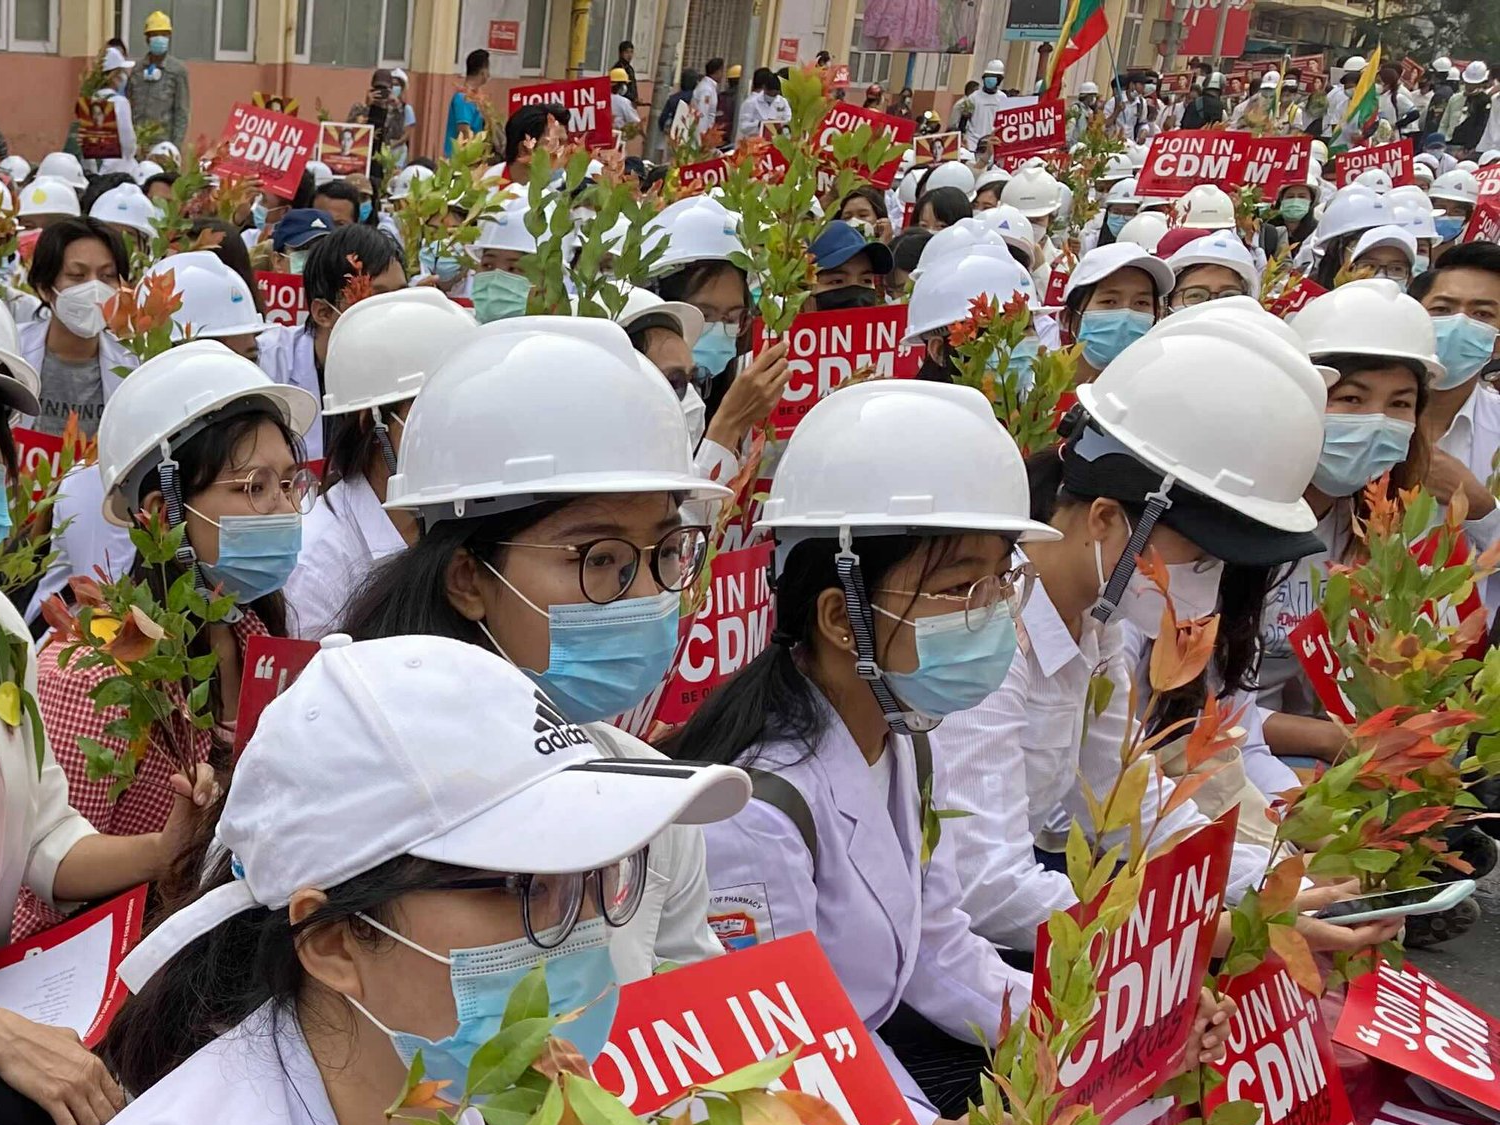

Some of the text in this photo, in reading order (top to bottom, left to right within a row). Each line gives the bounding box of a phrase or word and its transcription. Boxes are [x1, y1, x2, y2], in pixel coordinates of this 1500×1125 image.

[573, 87, 595, 106] IN
[234, 108, 303, 146] “JOIN IN
[997, 106, 1055, 127] “JOIN IN
[1002, 115, 1062, 143] CDM”
[229, 132, 307, 171] CDM”
[1155, 137, 1234, 156] “JOIN IN
[1256, 147, 1277, 162] IN
[1338, 147, 1402, 170] “JOIN IN
[1153, 153, 1242, 180] CDM”
[866, 321, 897, 350] IN
[681, 690, 698, 704] BE
[534, 724, 592, 755] adida
[724, 896, 763, 909] PHARMACY
[1167, 855, 1211, 932] IN
[1274, 969, 1305, 1022] IN
[1355, 984, 1422, 1050] “JOIN
[590, 1010, 725, 1108] OIN
[726, 981, 816, 1062] IN
